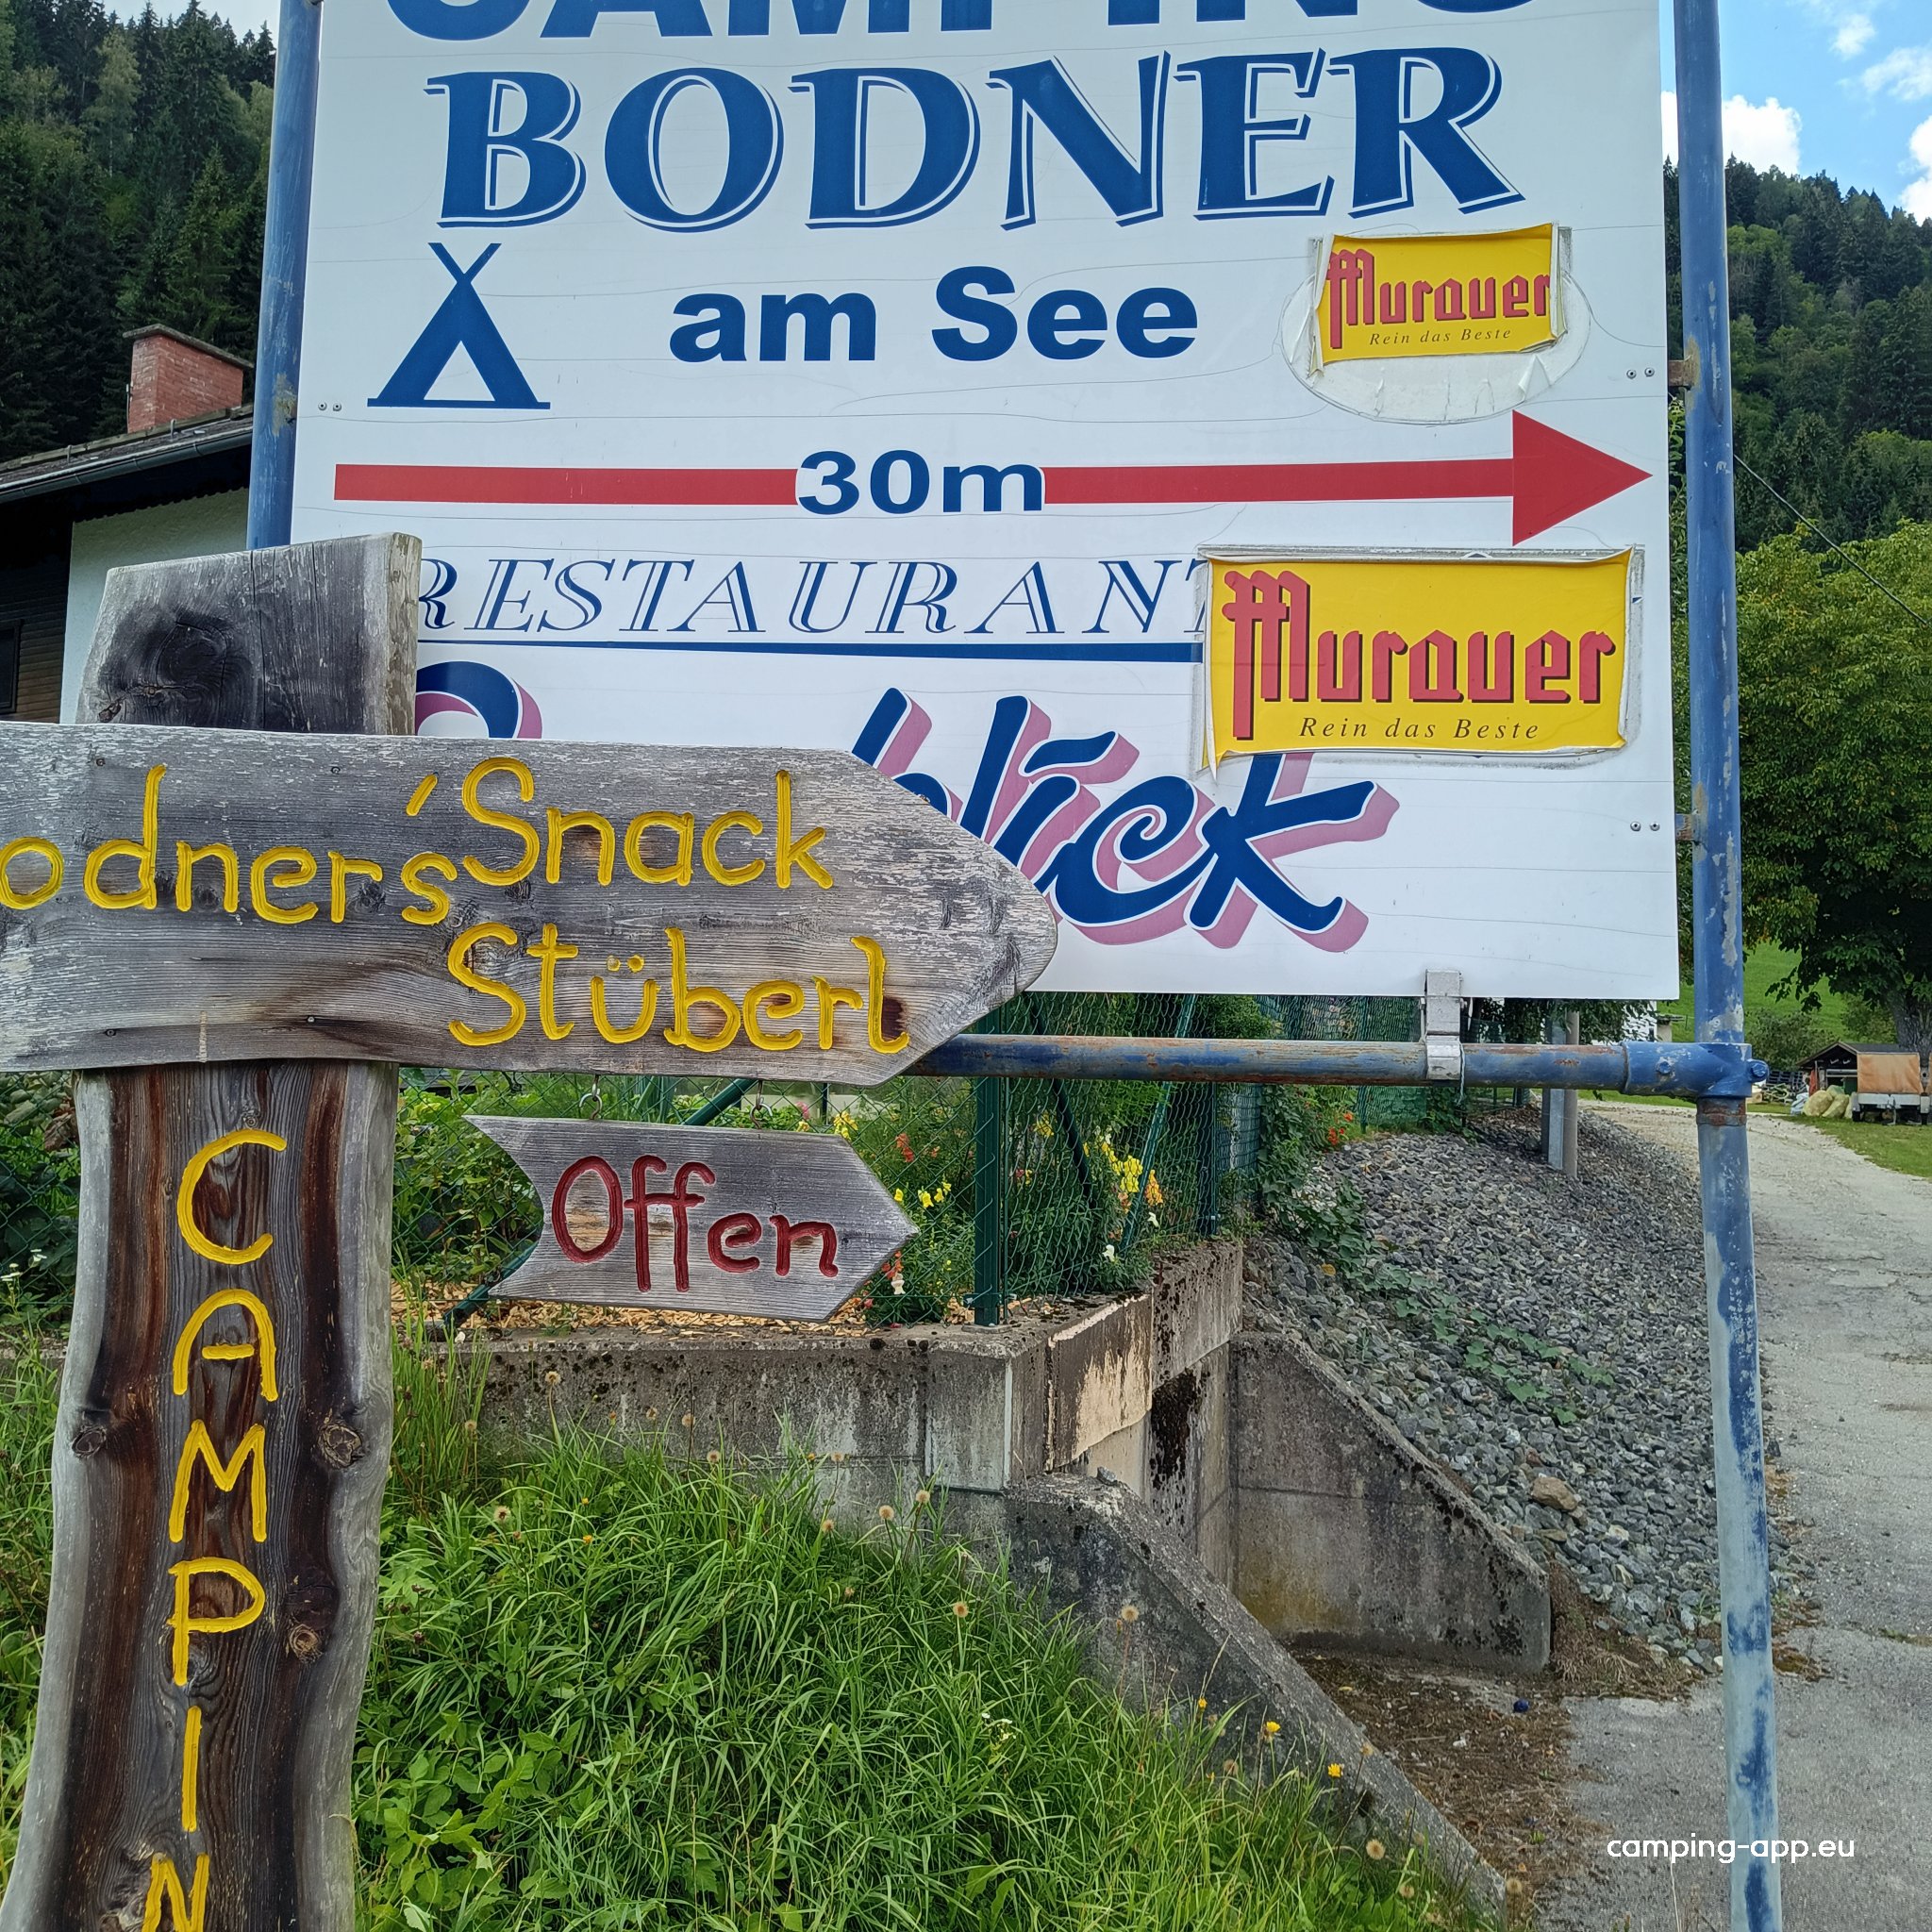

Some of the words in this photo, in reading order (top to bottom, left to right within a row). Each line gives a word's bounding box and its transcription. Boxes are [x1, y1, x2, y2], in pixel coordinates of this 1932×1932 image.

[424, 47, 1526, 232] BODNER
[669, 292, 876, 363] am
[931, 265, 1198, 362] See
[1325, 248, 1551, 350] Murauer
[1369, 331, 1410, 346] Rein
[1420, 329, 1451, 343] das
[1460, 327, 1512, 341] Beste
[798, 449, 1042, 515] 30m
[418, 558, 1206, 635] RESTAURAN
[1221, 570, 1617, 741] Murauer
[1298, 716, 1369, 739] Rein
[1384, 716, 1437, 740] das
[1454, 717, 1540, 740] Beste
[461, 757, 833, 888] Snack
[446, 922, 910, 1056] Stüberl
[551, 1154, 840, 1292] Offen
[142, 1128, 288, 1932] CAMPIN
